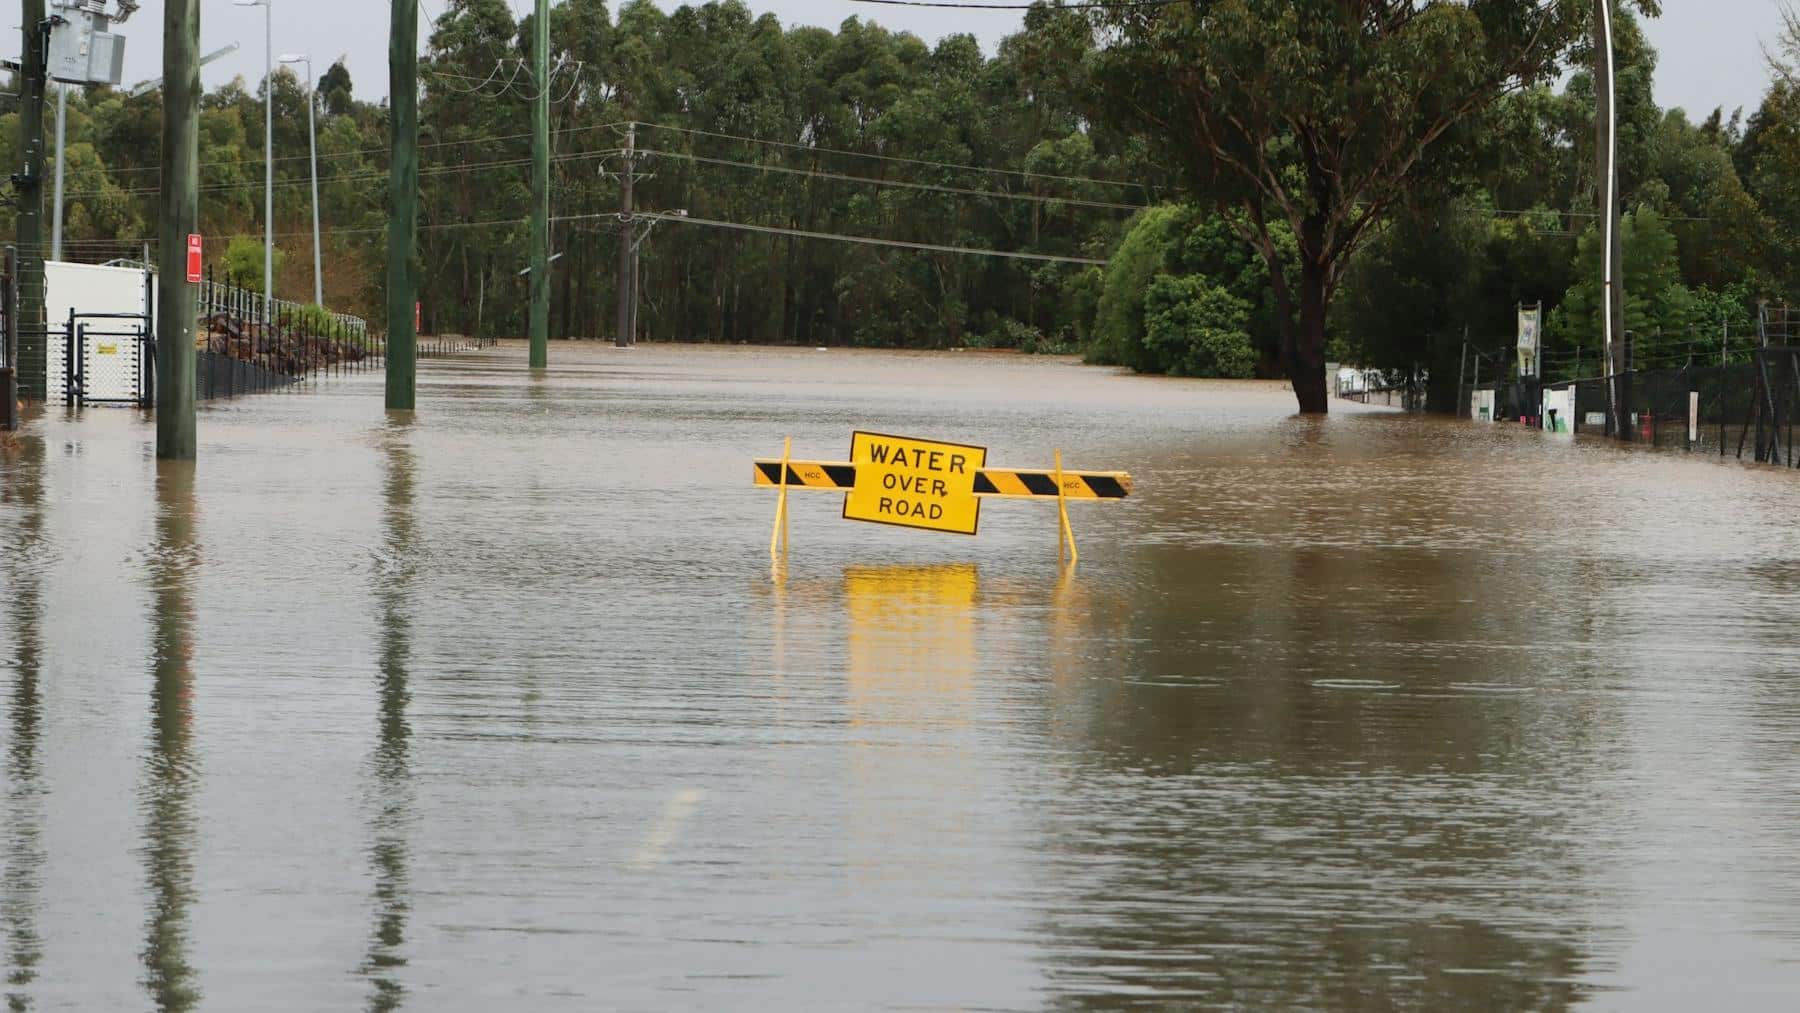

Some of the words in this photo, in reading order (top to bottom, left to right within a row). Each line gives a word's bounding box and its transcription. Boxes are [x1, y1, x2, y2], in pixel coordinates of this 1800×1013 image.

[870, 443, 966, 474] WATER
[883, 473, 946, 497] OVER
[879, 497, 943, 520] ROAD
